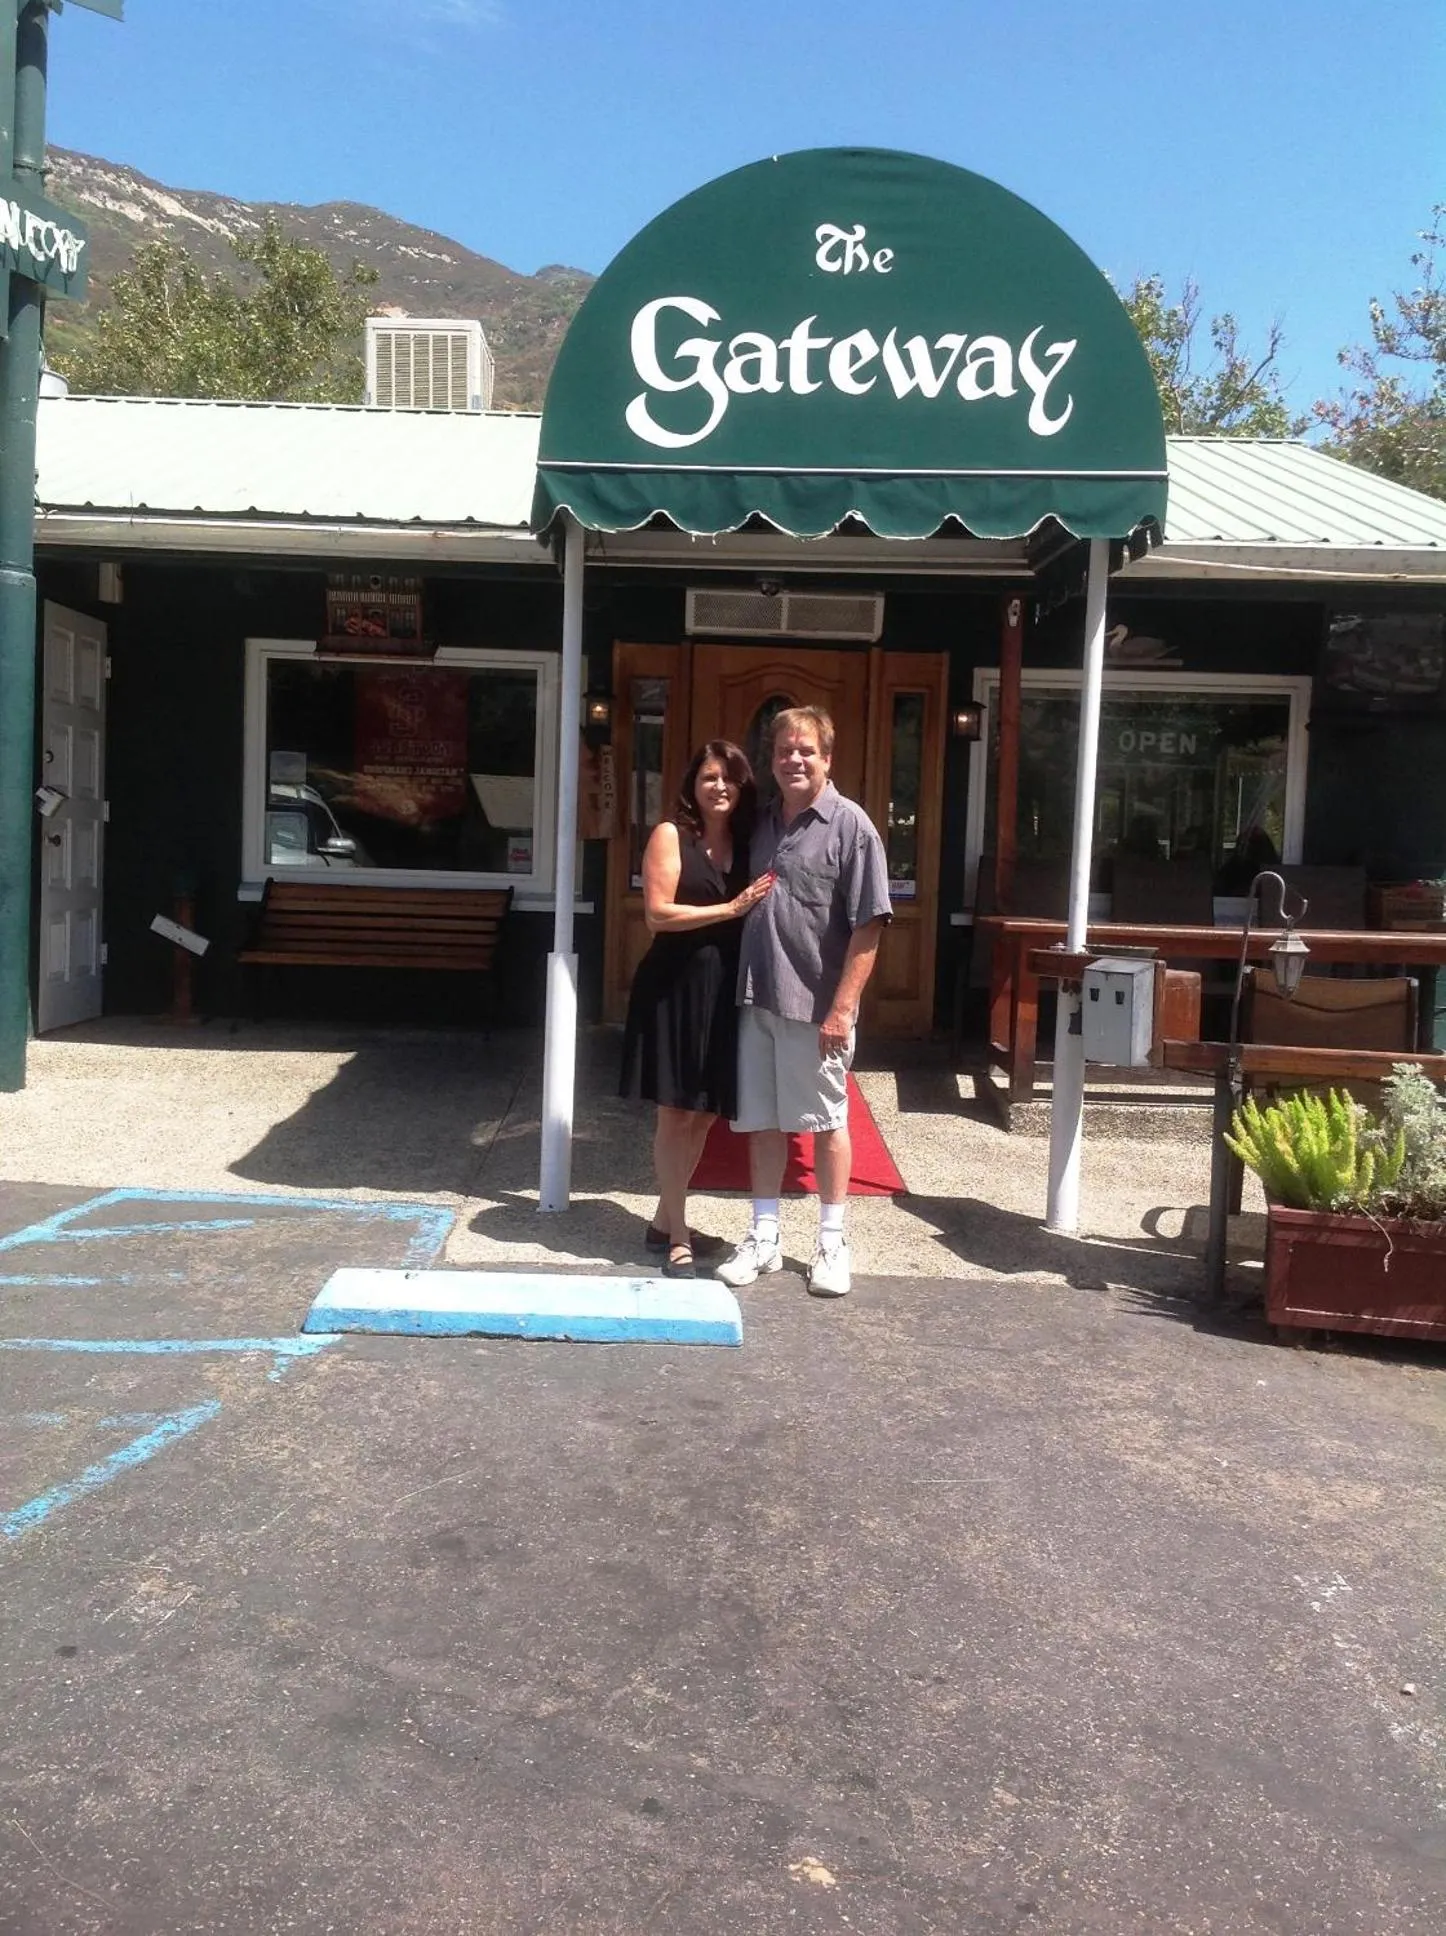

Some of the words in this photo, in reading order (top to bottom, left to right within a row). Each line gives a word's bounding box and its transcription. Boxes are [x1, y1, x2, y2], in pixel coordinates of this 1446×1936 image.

[815, 223, 894, 275] The
[625, 296, 1078, 449] Gateway
[1119, 731, 1197, 754] OPEN
